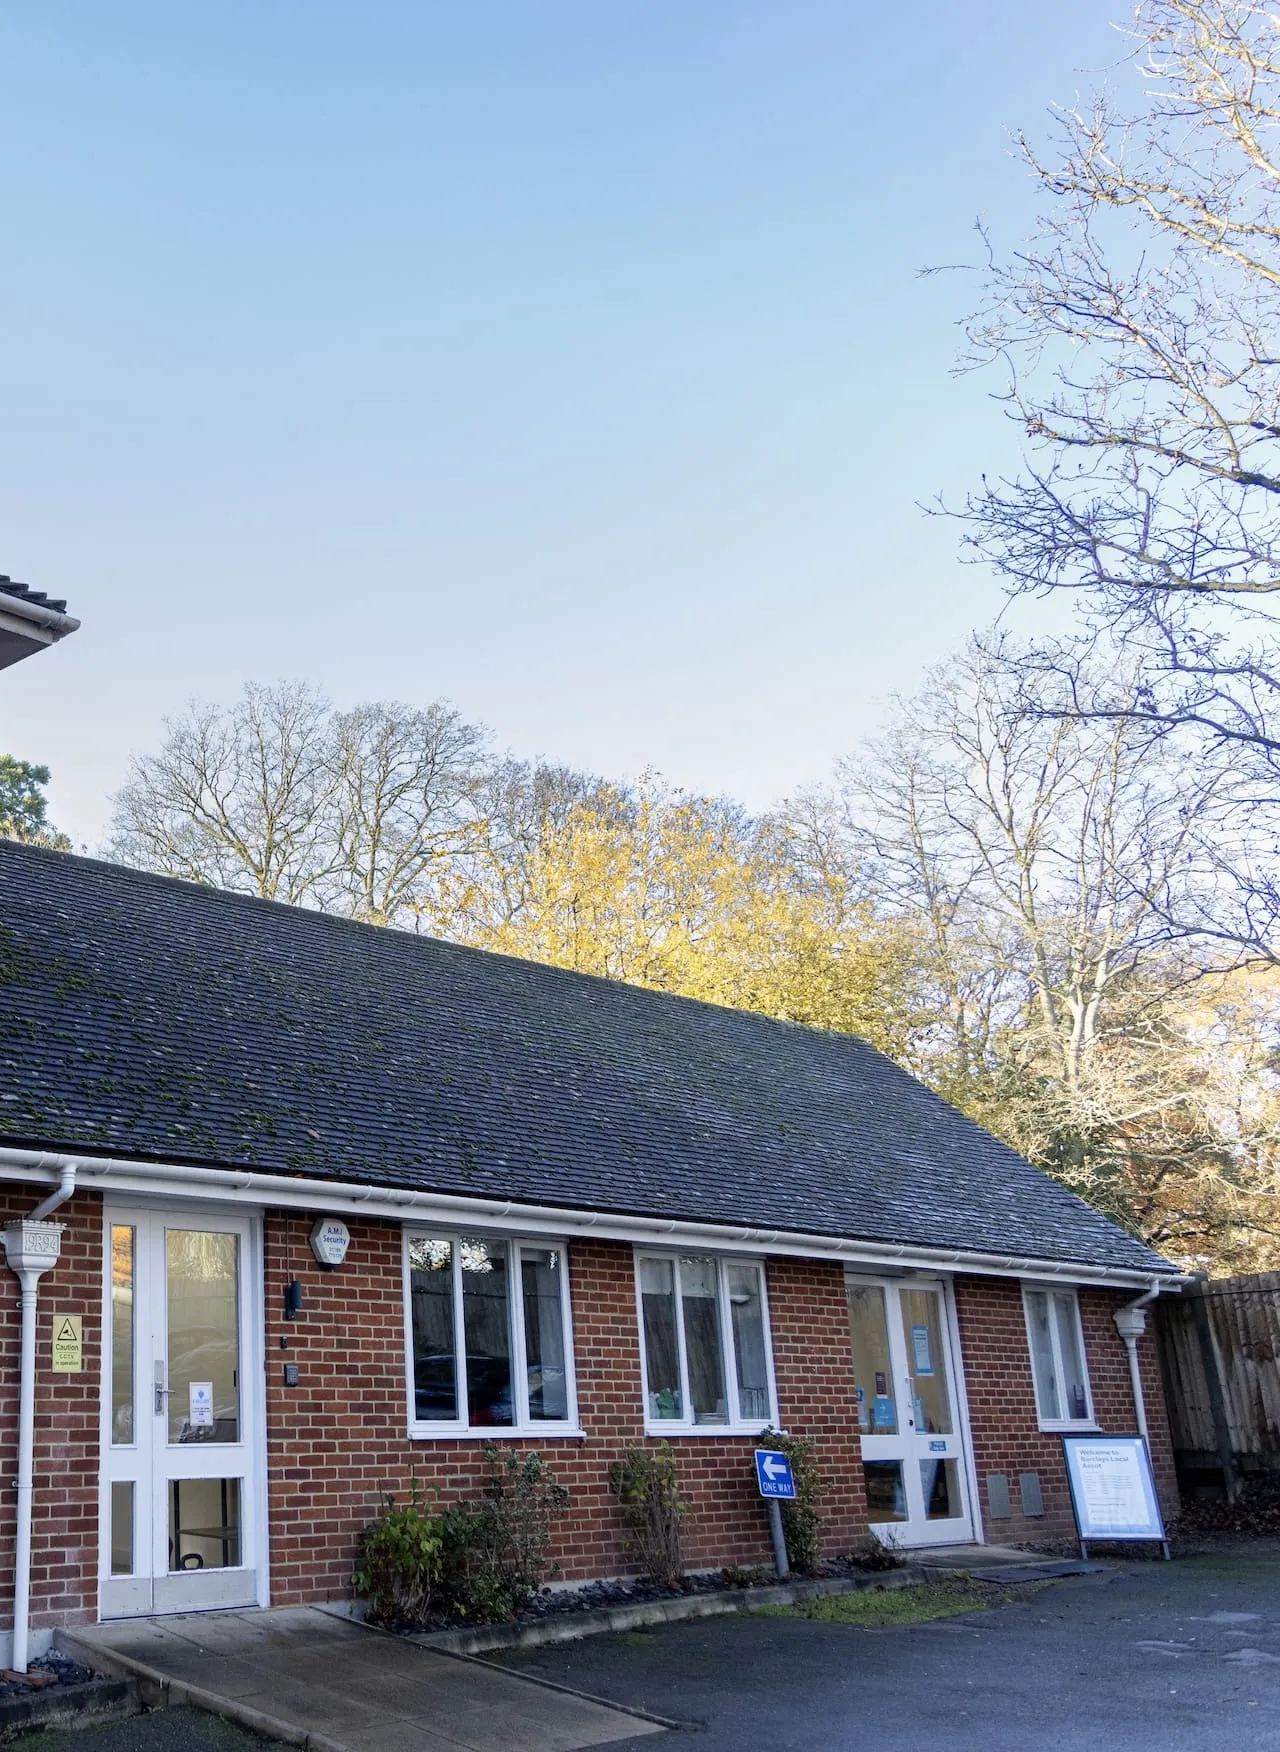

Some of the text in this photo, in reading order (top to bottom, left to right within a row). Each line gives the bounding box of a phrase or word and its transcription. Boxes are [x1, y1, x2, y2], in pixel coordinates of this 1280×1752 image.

[323, 1234, 346, 1246] Security
[55, 1343, 79, 1351] Caution
[762, 1481, 791, 1493] ONE WAY
